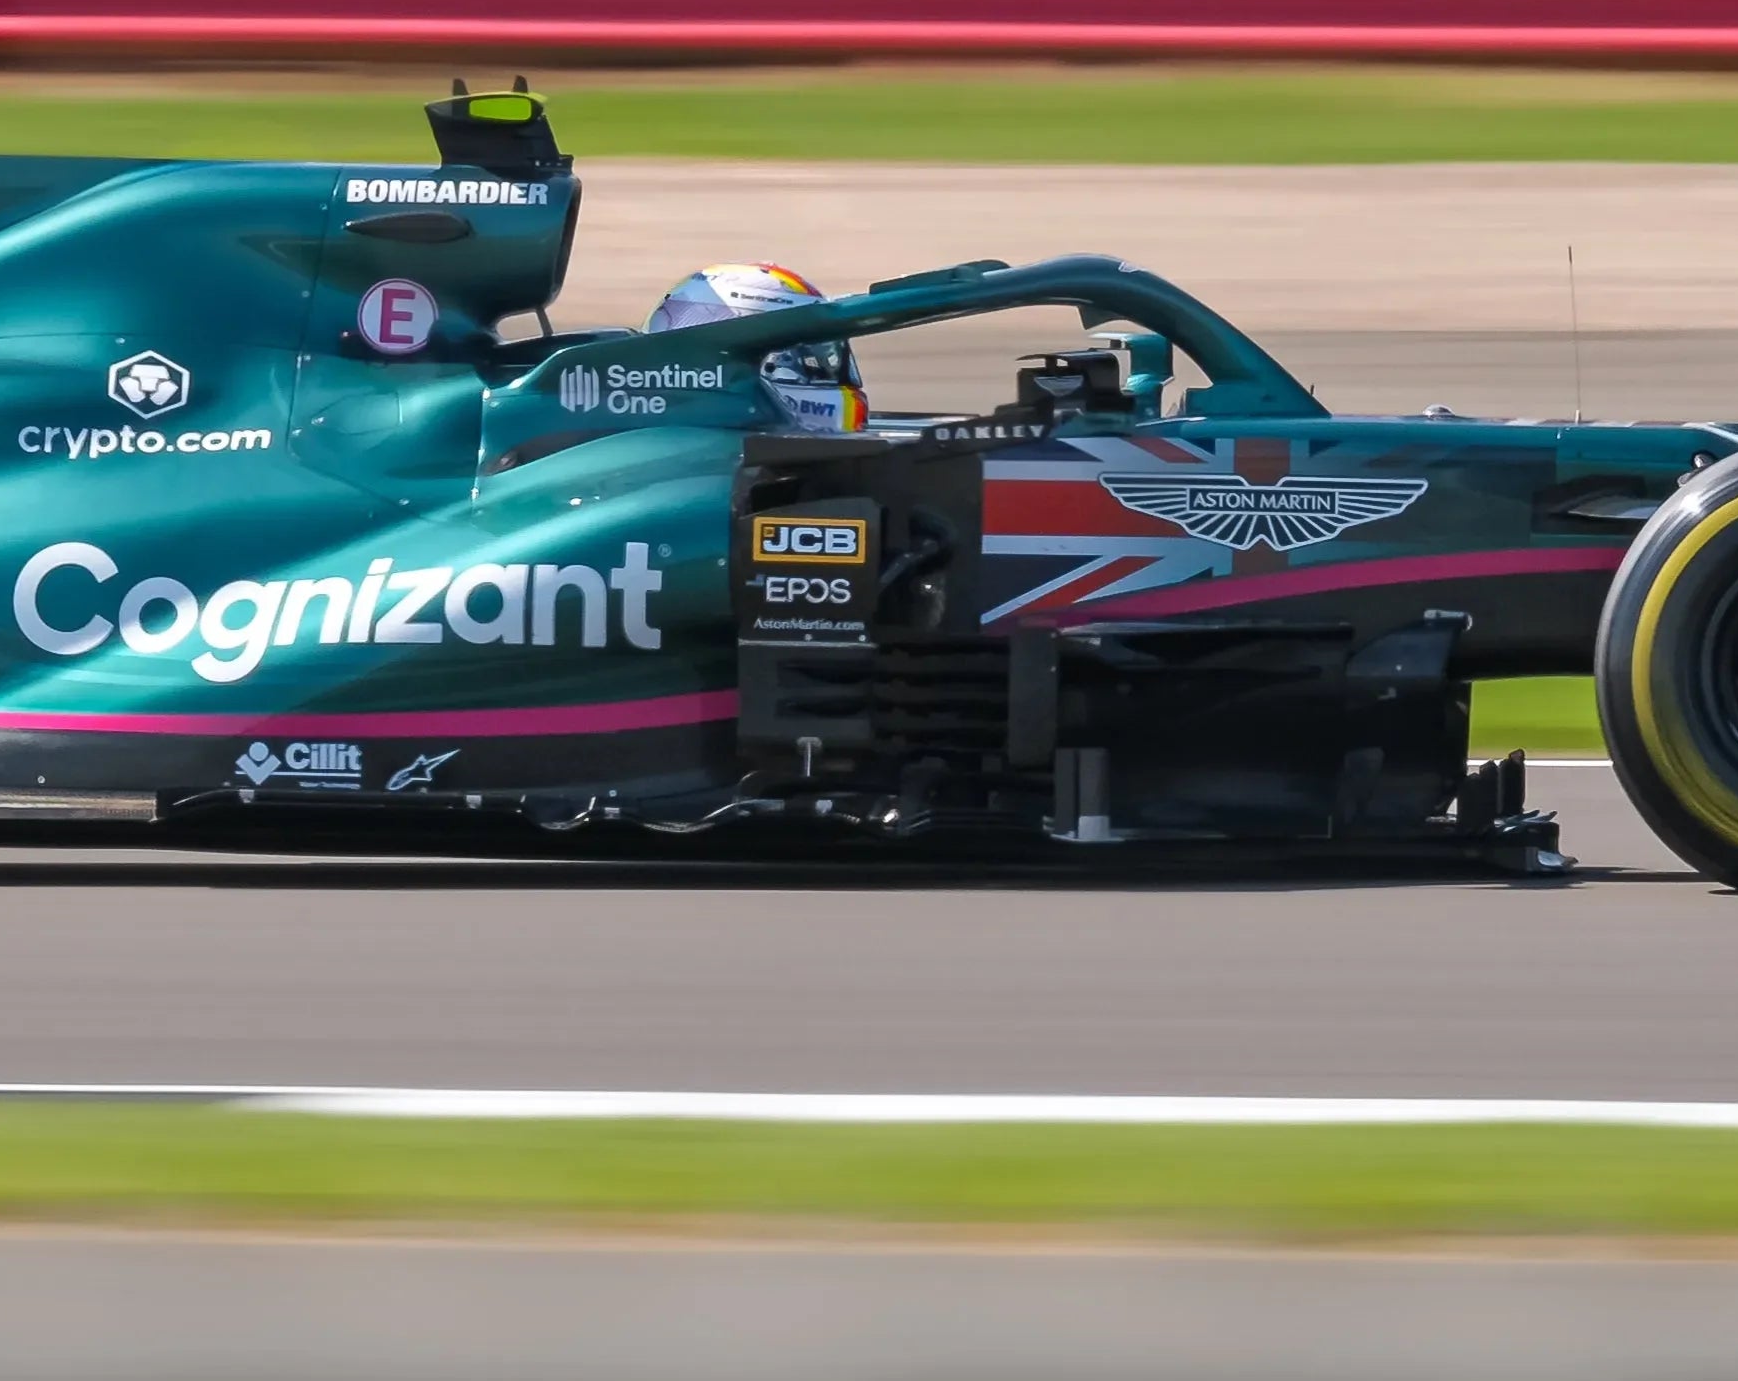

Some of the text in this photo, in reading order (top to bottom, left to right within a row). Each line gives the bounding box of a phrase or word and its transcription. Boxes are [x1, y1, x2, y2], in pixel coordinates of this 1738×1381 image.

[346, 179, 549, 205] BOMBARDIER
[378, 287, 417, 345] E
[606, 363, 724, 389] Sentinel
[606, 389, 667, 414] One
[799, 399, 836, 418] BWT
[17, 424, 273, 460] crypto.com
[934, 424, 1044, 441] OAKLEY
[1192, 491, 1332, 511] ASTON MARTIN
[762, 526, 857, 554] JCB
[765, 576, 852, 604] EPOS
[13, 541, 663, 684] Cognizant
[753, 617, 866, 632] AstonMartin.com
[284, 741, 362, 771] Cillit
